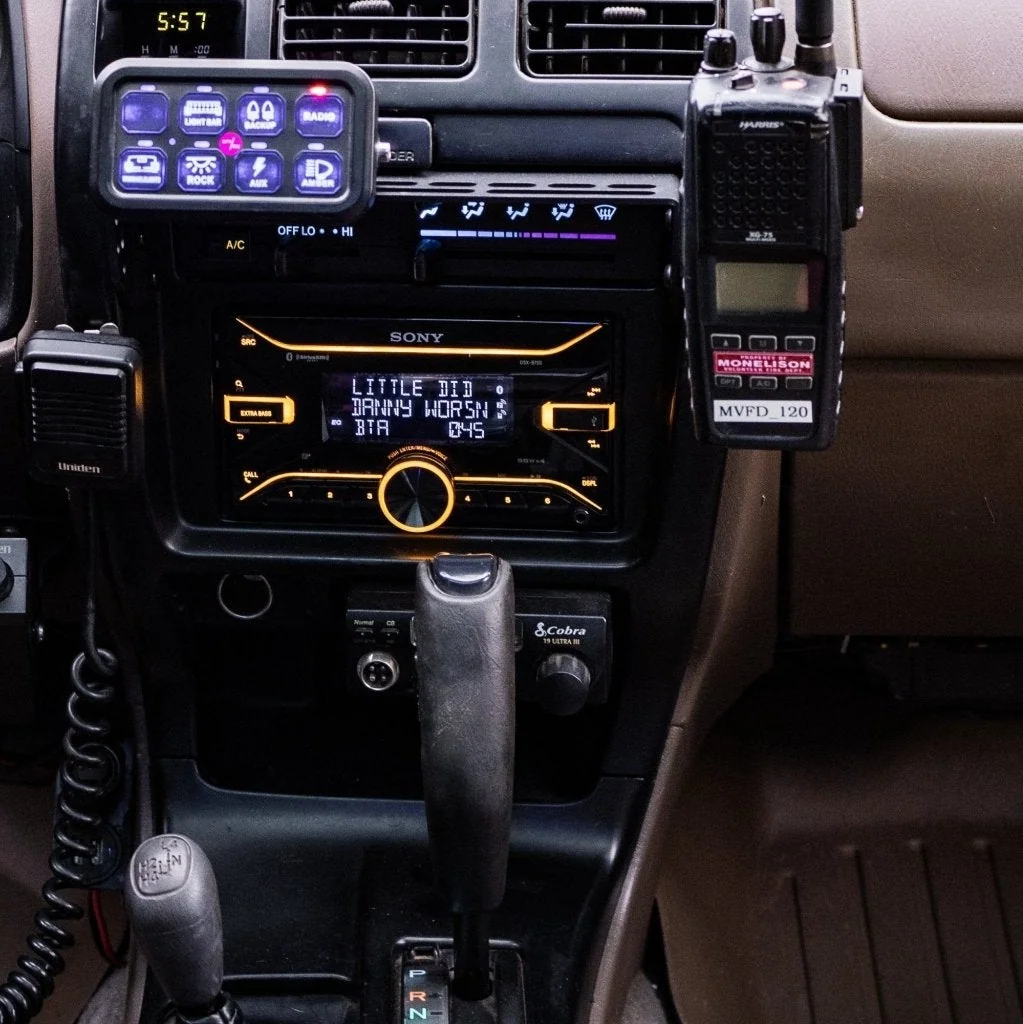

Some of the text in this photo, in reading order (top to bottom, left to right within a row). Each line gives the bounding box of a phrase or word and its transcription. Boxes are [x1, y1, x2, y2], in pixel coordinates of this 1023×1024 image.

[157, 11, 207, 32] 5:57
[142, 45, 149, 54] H
[170, 45, 179, 54] M
[302, 111, 336, 122] RADIO
[186, 175, 215, 186] ROCK
[249, 179, 269, 188] AUX
[300, 179, 336, 188] AMBER
[277, 225, 354, 237] OFF LO HI
[226, 239, 245, 250] A/C
[240, 338, 257, 346] SRC
[389, 331, 444, 343] SONY
[717, 359, 811, 369] MONELISON
[352, 378, 473, 398] LITTLE DID
[351, 397, 488, 419] DANNY WORSN
[354, 419, 389, 436] BTA
[57, 461, 101, 474] Uniden
[288, 490, 294, 498] 1
[327, 491, 334, 499] 2
[366, 492, 373, 500] 3
[504, 496, 511, 504] 5
[546, 625, 587, 636] Cobra
[408, 969, 427, 979] P
[408, 991, 427, 1002] R
[408, 1007, 427, 1020] N
